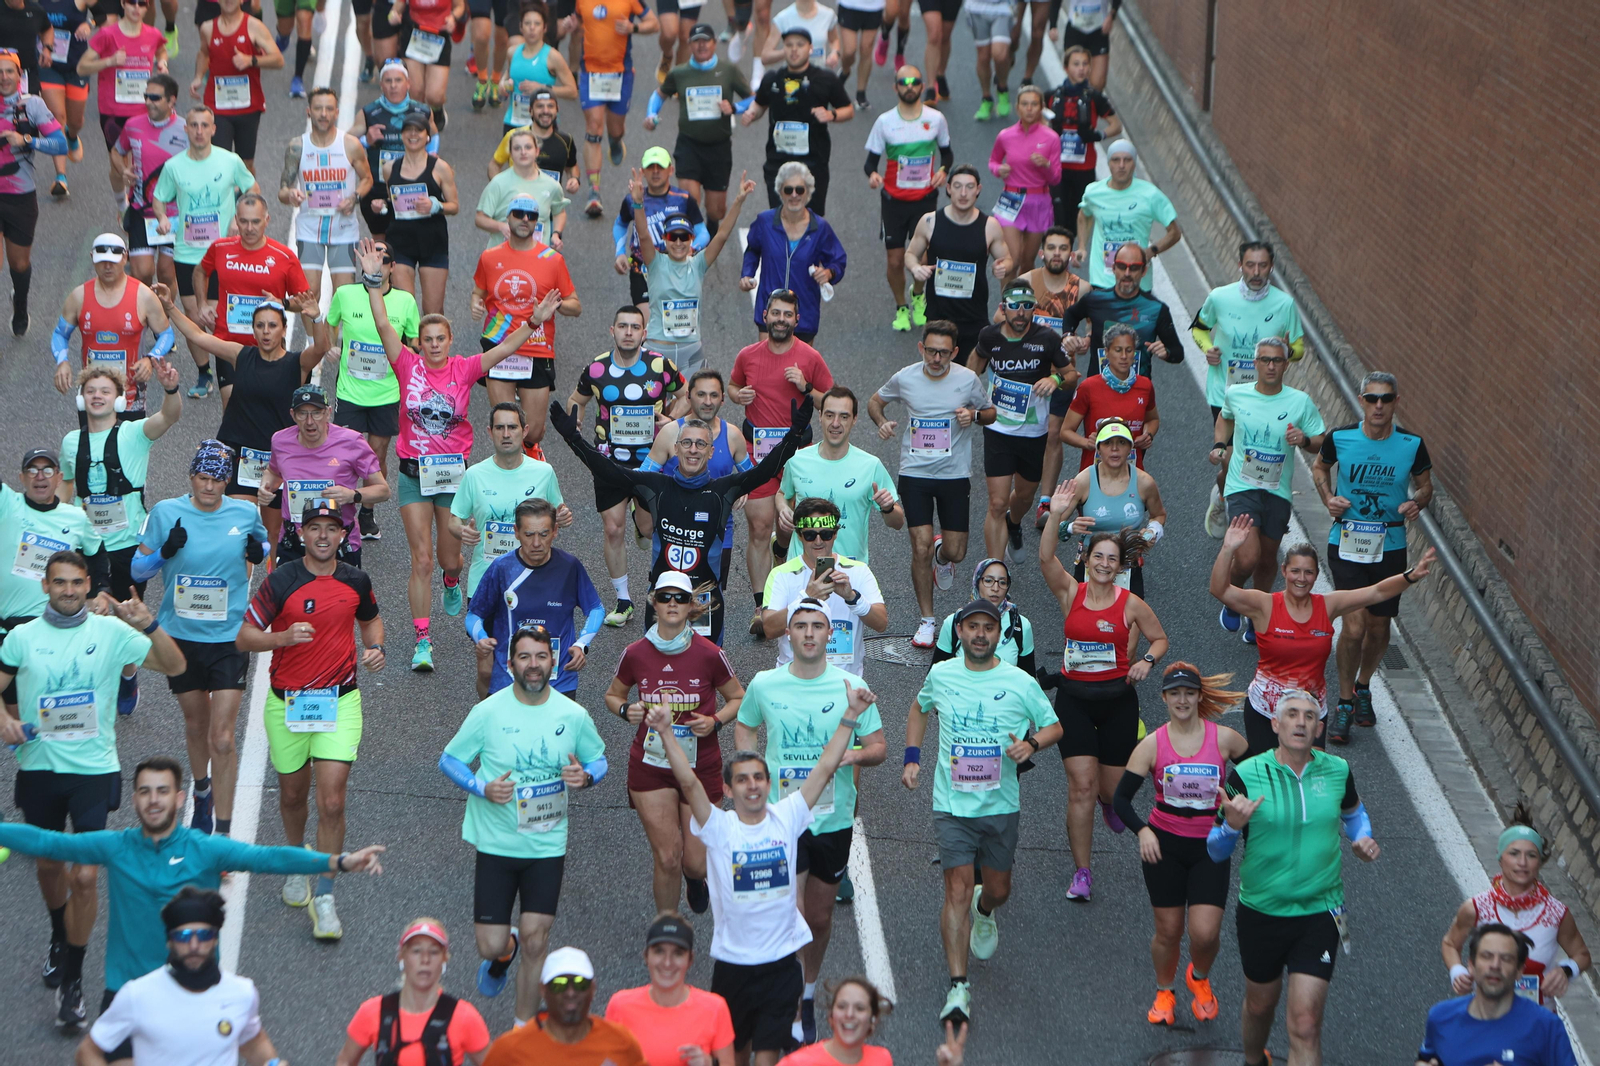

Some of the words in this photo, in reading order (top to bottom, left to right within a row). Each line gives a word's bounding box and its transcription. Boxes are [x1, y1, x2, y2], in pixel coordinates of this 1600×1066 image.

[302, 169, 347, 182] MADRID
[402, 185, 423, 194] ZURICH
[226, 260, 270, 275] CANADA
[949, 263, 972, 272] ZURICH
[947, 275, 963, 284] 10022
[241, 297, 265, 305] ZURICH
[676, 301, 694, 309] ZURICH
[362, 344, 384, 353] ZURICH
[96, 352, 121, 360] ZURICH
[360, 356, 377, 365] 10260
[1003, 382, 1027, 393] ZURICH
[921, 420, 944, 428] ZURICH
[922, 433, 936, 441] 7723
[435, 456, 458, 464] ZURICH
[1258, 454, 1281, 463] ZURICH
[435, 469, 451, 478] 9435
[1349, 463, 1367, 484] VI
[1367, 464, 1396, 478] TRAIL
[303, 482, 327, 490] ZURICH
[92, 496, 117, 504] ZURICH
[660, 517, 704, 540] George
[1356, 526, 1381, 534] ZURICH
[39, 538, 66, 552] ZURICH
[1353, 537, 1372, 546] 11085
[669, 547, 694, 565] 30
[193, 578, 222, 588] ZURICH
[1081, 643, 1108, 652] ZURICH
[301, 687, 331, 697] ZURICH
[57, 694, 89, 706] ZURICH
[302, 703, 320, 712] 5299
[952, 736, 999, 745] SEVILLA'24
[783, 753, 820, 761] SEVILLA'
[966, 748, 996, 757] ZURICH
[966, 764, 984, 772] 7622
[1182, 766, 1212, 775] ZURICH
[535, 784, 562, 797] ZURICH
[1181, 782, 1200, 790] 8402
[1178, 791, 1203, 799] JESSIKA
[535, 802, 552, 812] 9413
[527, 815, 542, 824] JUAN
[542, 811, 562, 820] CARLOS
[750, 849, 781, 863] ZURICH
[754, 880, 770, 889] DANI
